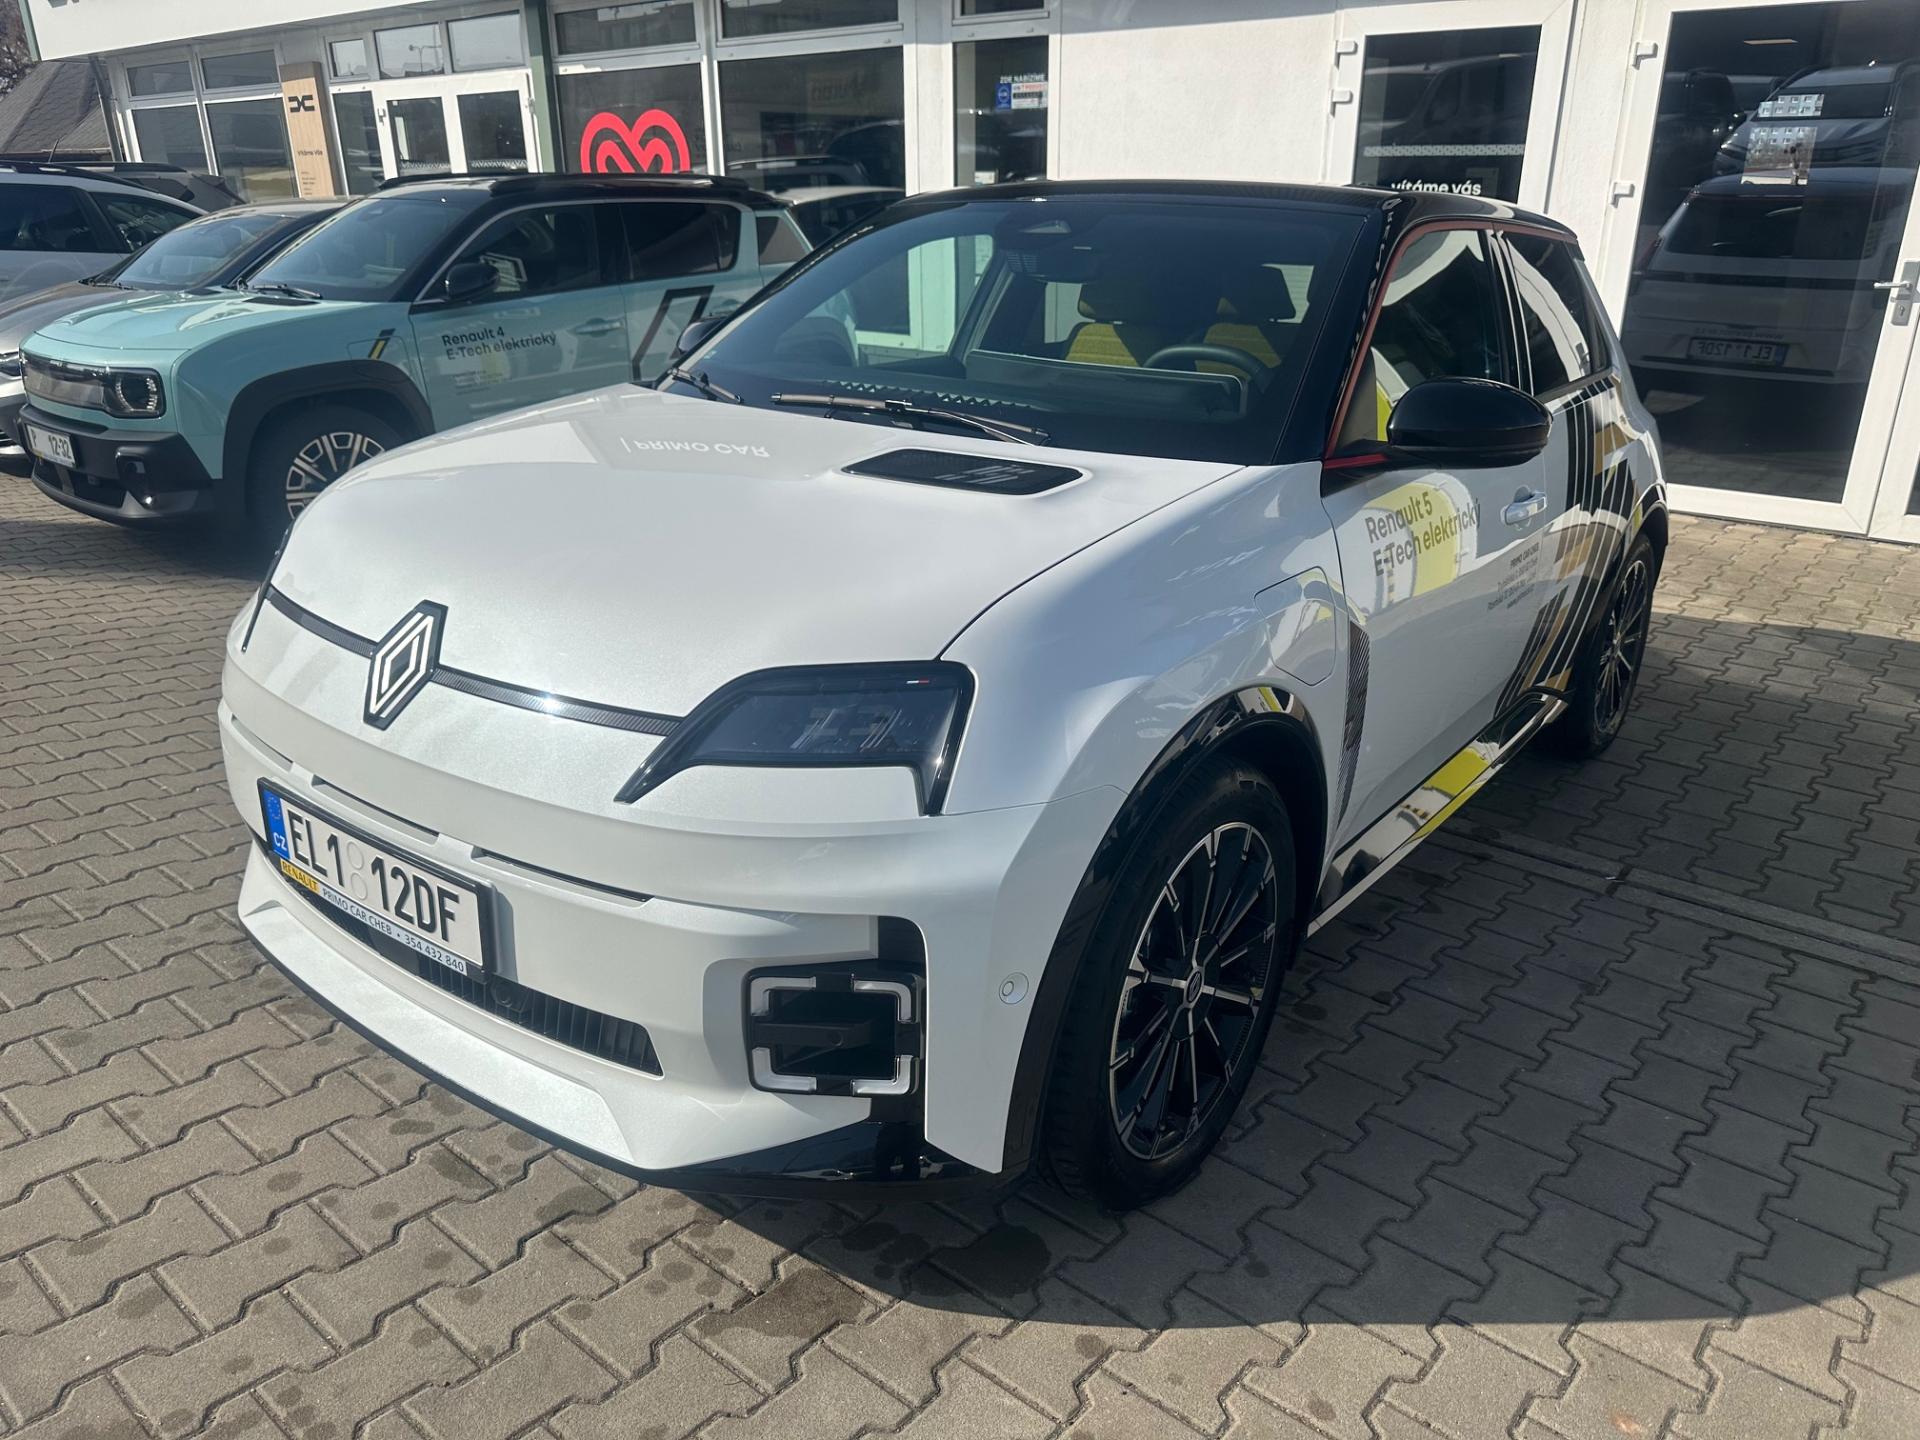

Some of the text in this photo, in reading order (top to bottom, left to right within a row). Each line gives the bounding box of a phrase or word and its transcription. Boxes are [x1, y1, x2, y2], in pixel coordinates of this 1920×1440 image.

[1452, 180, 1481, 195] vás
[441, 325, 505, 347] Renault 4
[446, 331, 557, 360] E-Tech elektrický
[1365, 491, 1433, 543] Renault 5
[1373, 497, 1480, 577] E-Tech elektrický
[273, 832, 287, 851] CZ
[281, 860, 319, 892] RENAULT
[287, 809, 460, 943] EL1 12DF
[322, 889, 465, 973] PRIMO CAR CHEB 354 432 840
